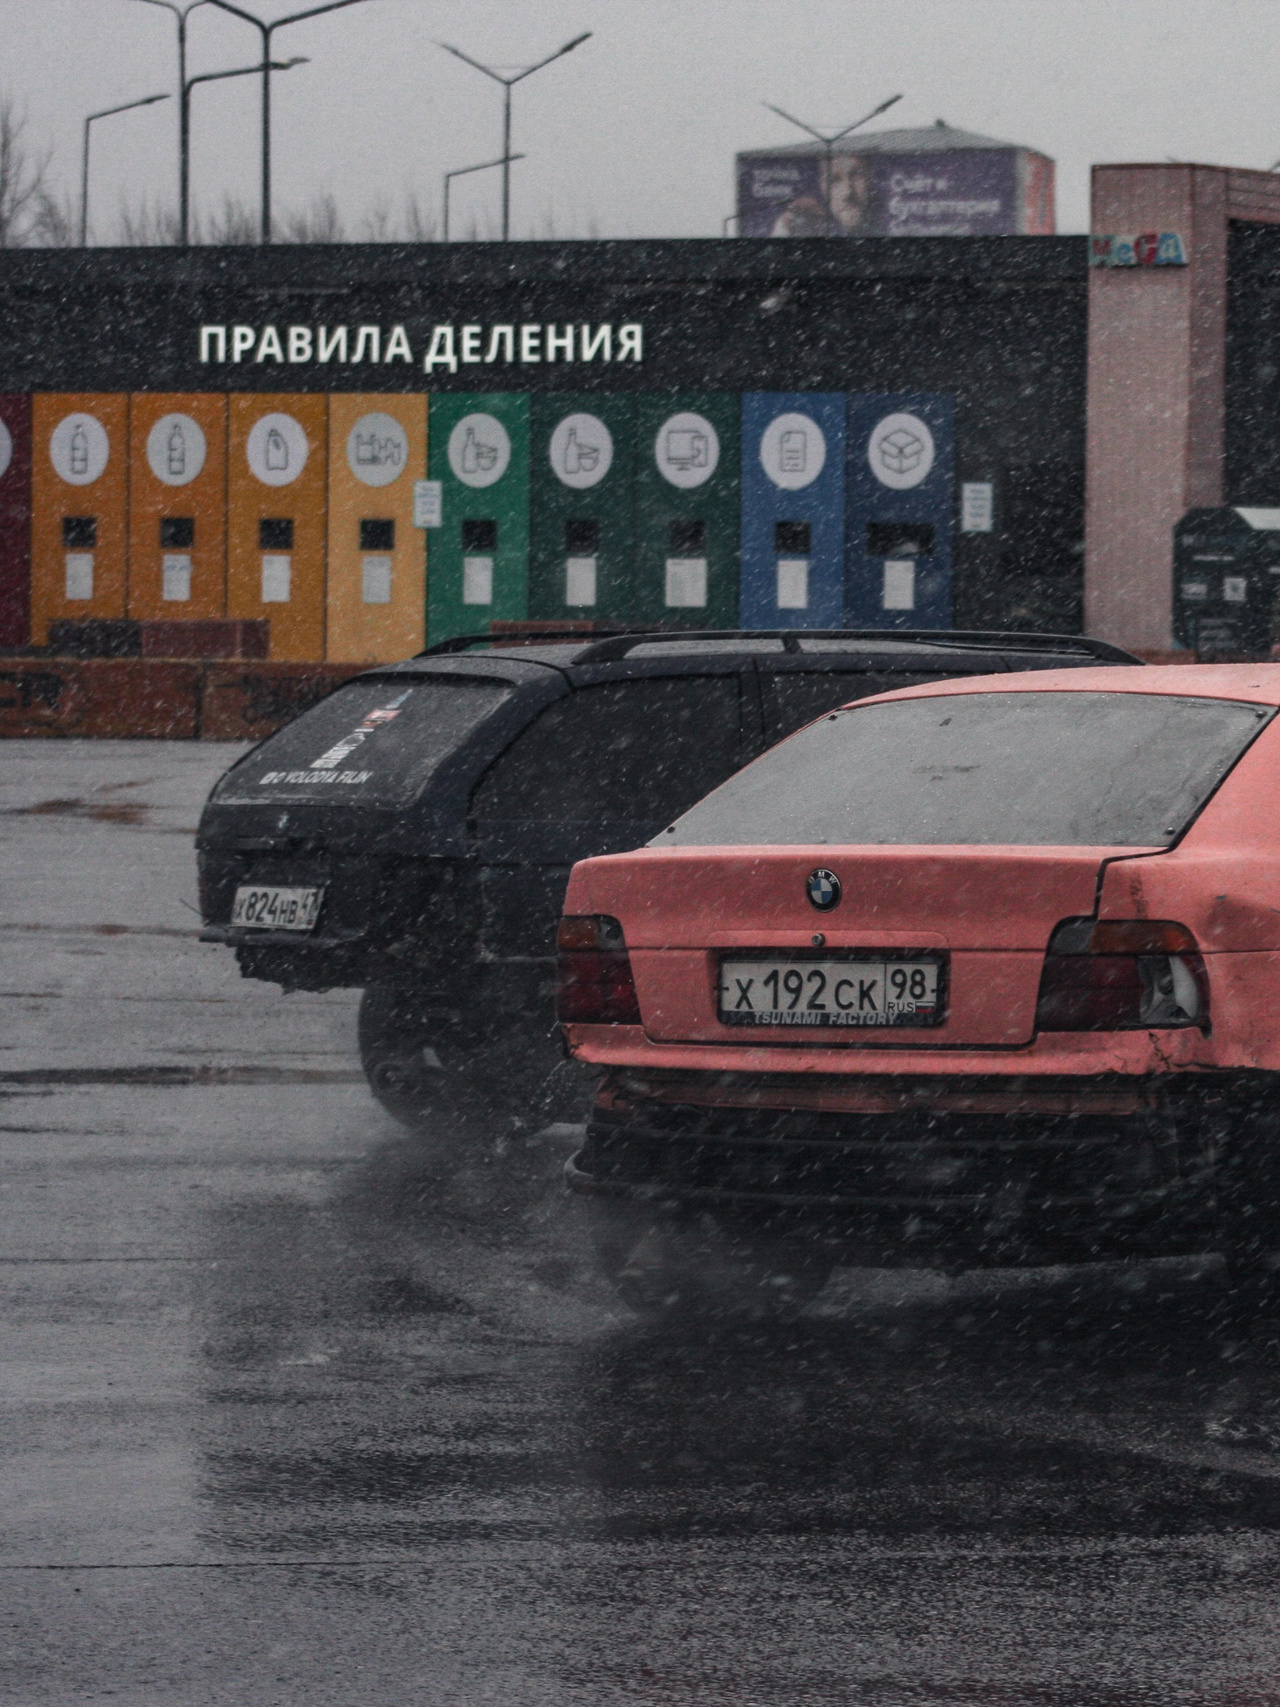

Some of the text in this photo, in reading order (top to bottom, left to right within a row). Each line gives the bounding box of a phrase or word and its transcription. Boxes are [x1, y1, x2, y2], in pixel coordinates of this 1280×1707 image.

[200, 324, 643, 374] ПРАВИЛА ДЕЛЕНИЯ
[890, 968, 926, 999] 98
[887, 1001, 915, 1013] RUS
[754, 1012, 898, 1025] TSUNAMI FACTORY
